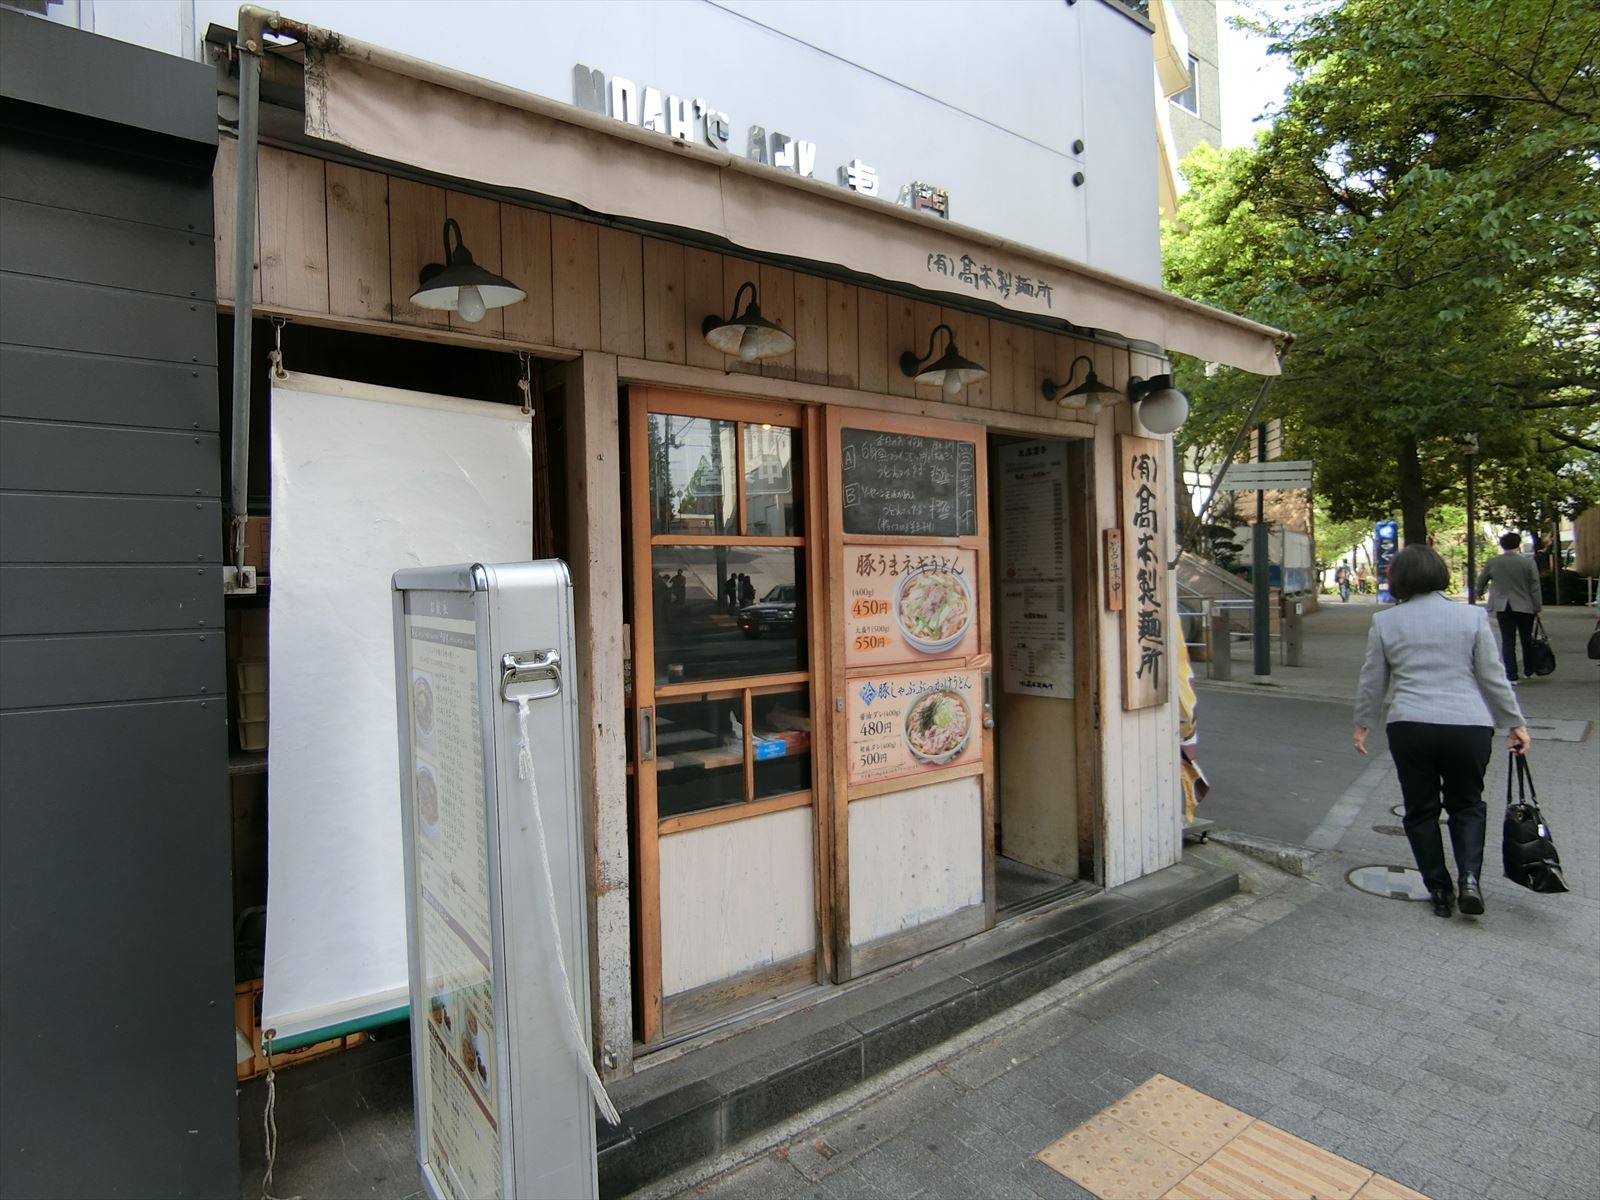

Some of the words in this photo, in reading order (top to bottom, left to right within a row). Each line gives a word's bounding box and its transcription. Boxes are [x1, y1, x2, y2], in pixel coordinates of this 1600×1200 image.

[856, 553, 964, 577] 豚うまネギうどん
[852, 600, 888, 615] 450円
[855, 636, 885, 650] 550円
[859, 721, 892, 736] 480円
[860, 752, 887, 767] 500円
